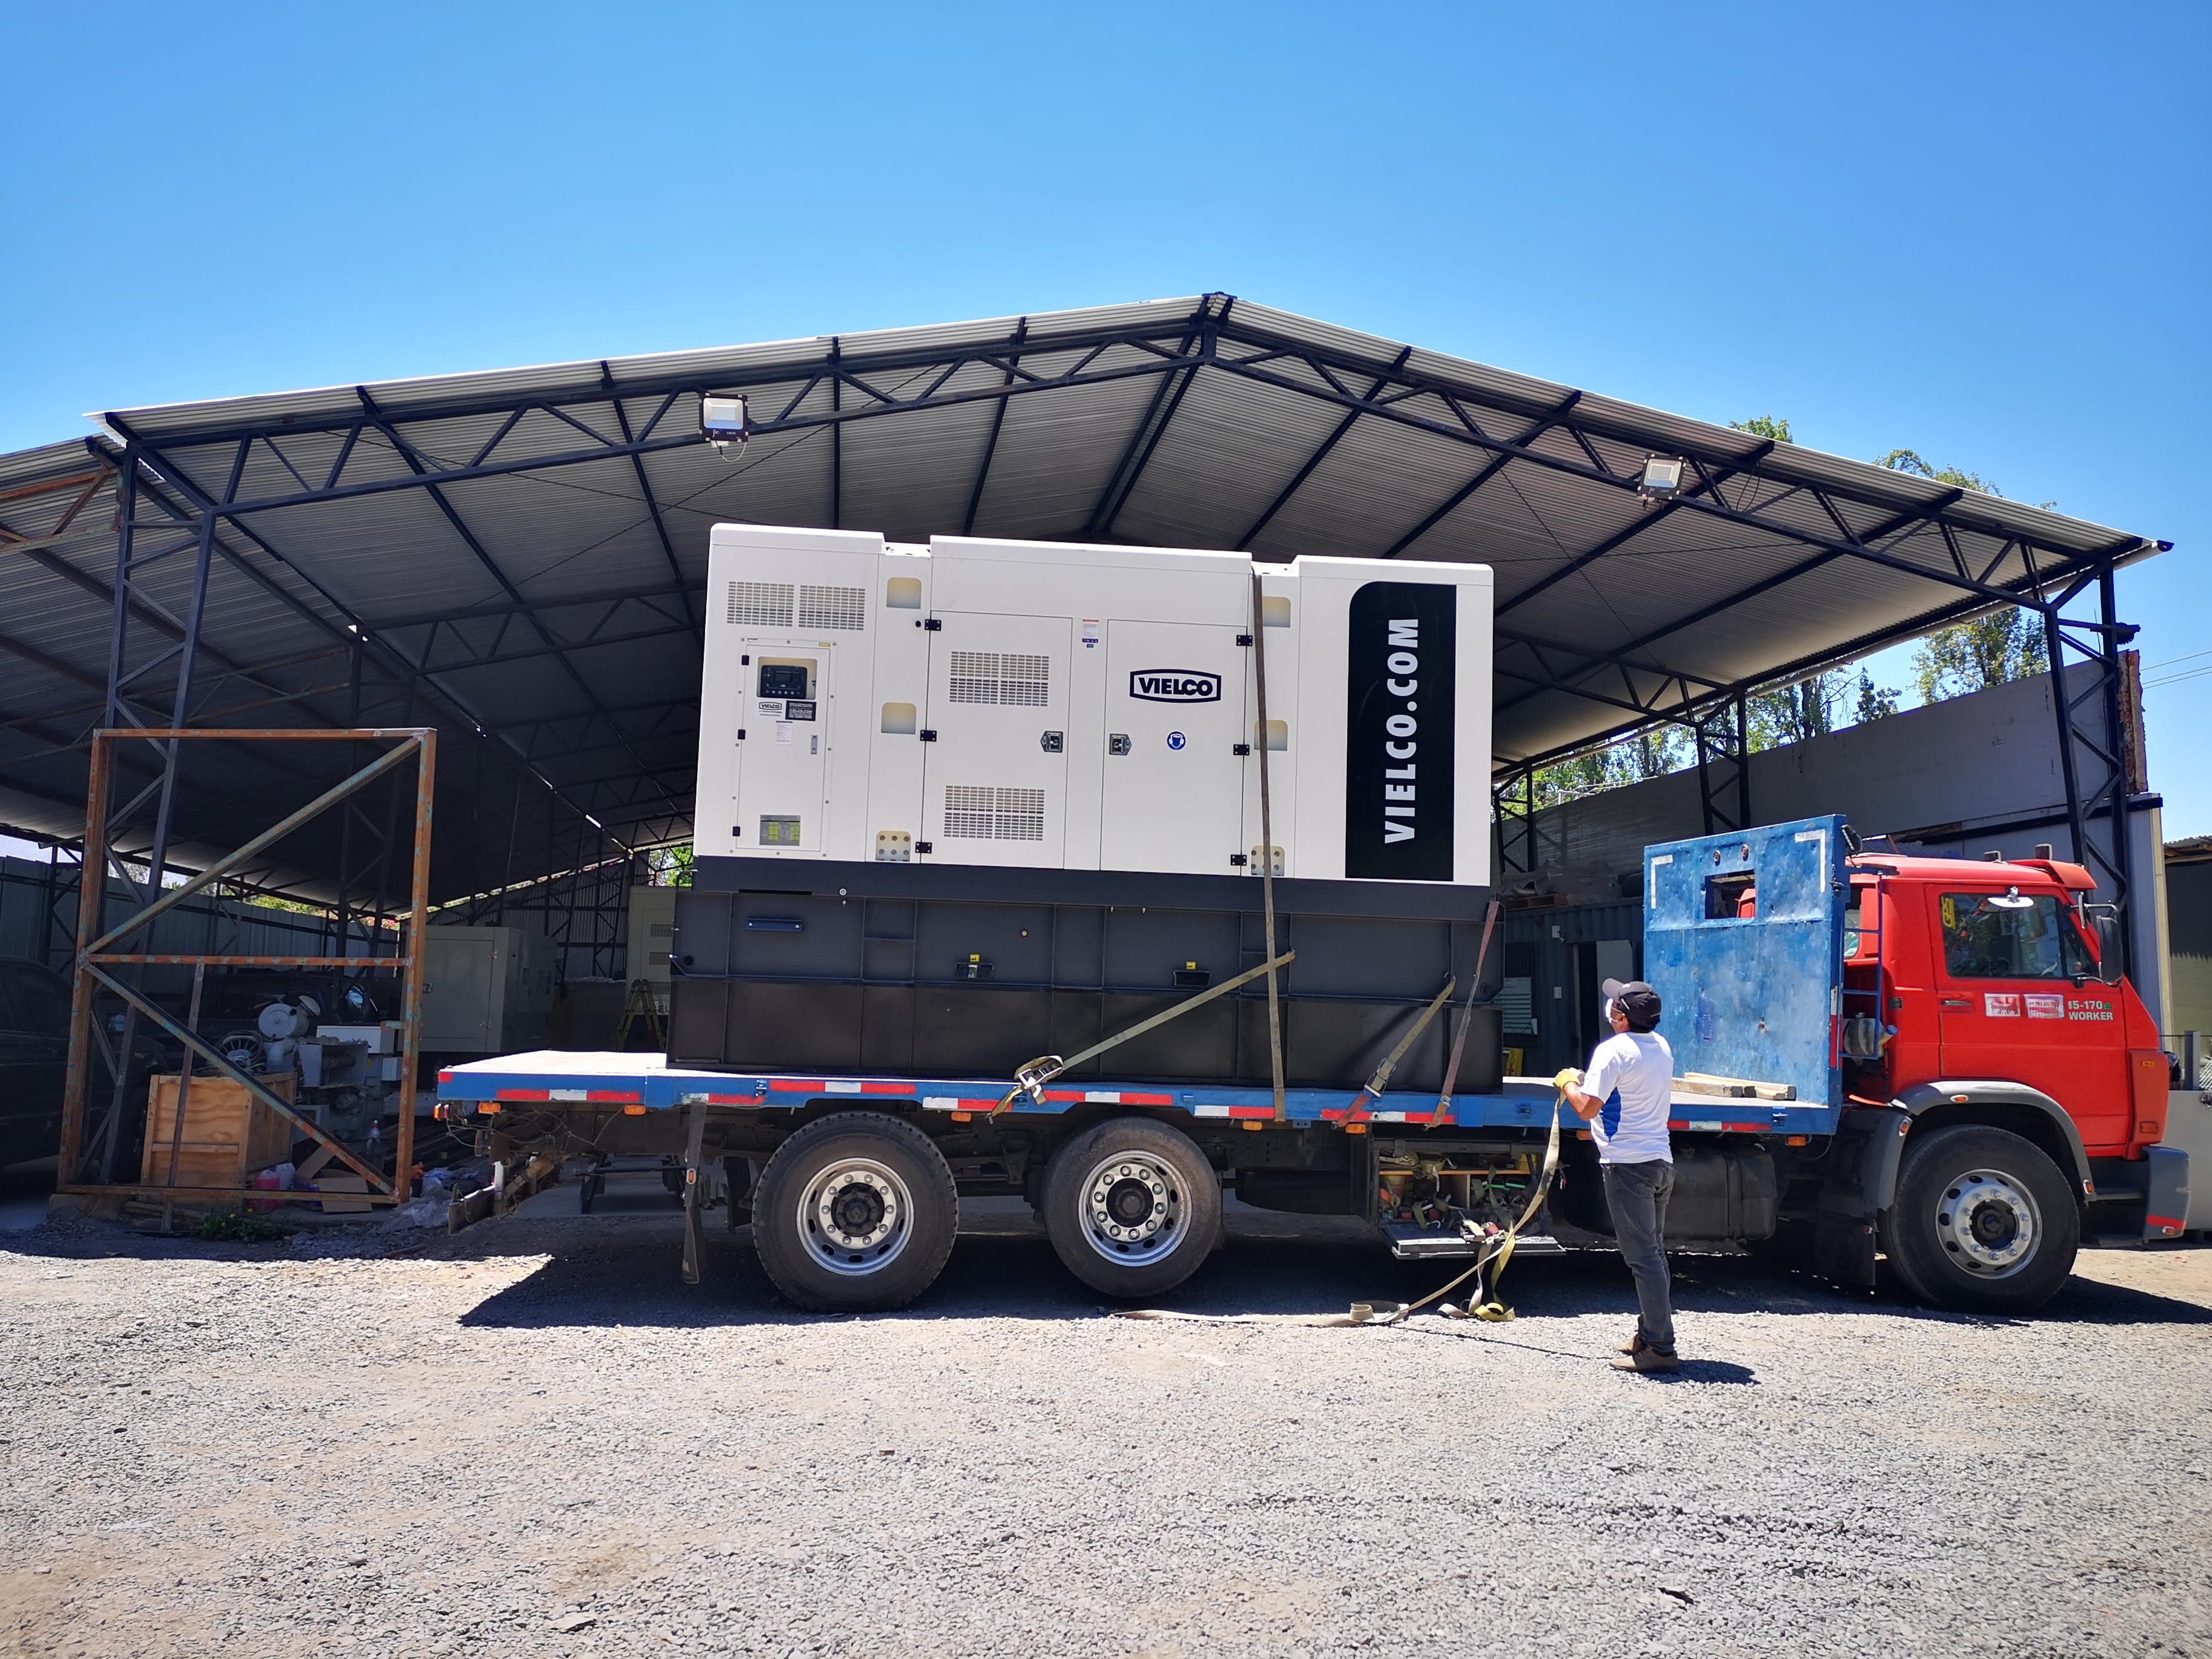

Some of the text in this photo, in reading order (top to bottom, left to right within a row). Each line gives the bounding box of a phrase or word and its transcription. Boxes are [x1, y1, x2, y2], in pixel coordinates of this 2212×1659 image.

[1138, 677, 1213, 696] VIELCO
[1384, 618, 1418, 843] VIELCO.COM
[2069, 1011, 2114, 1021] WORKER
